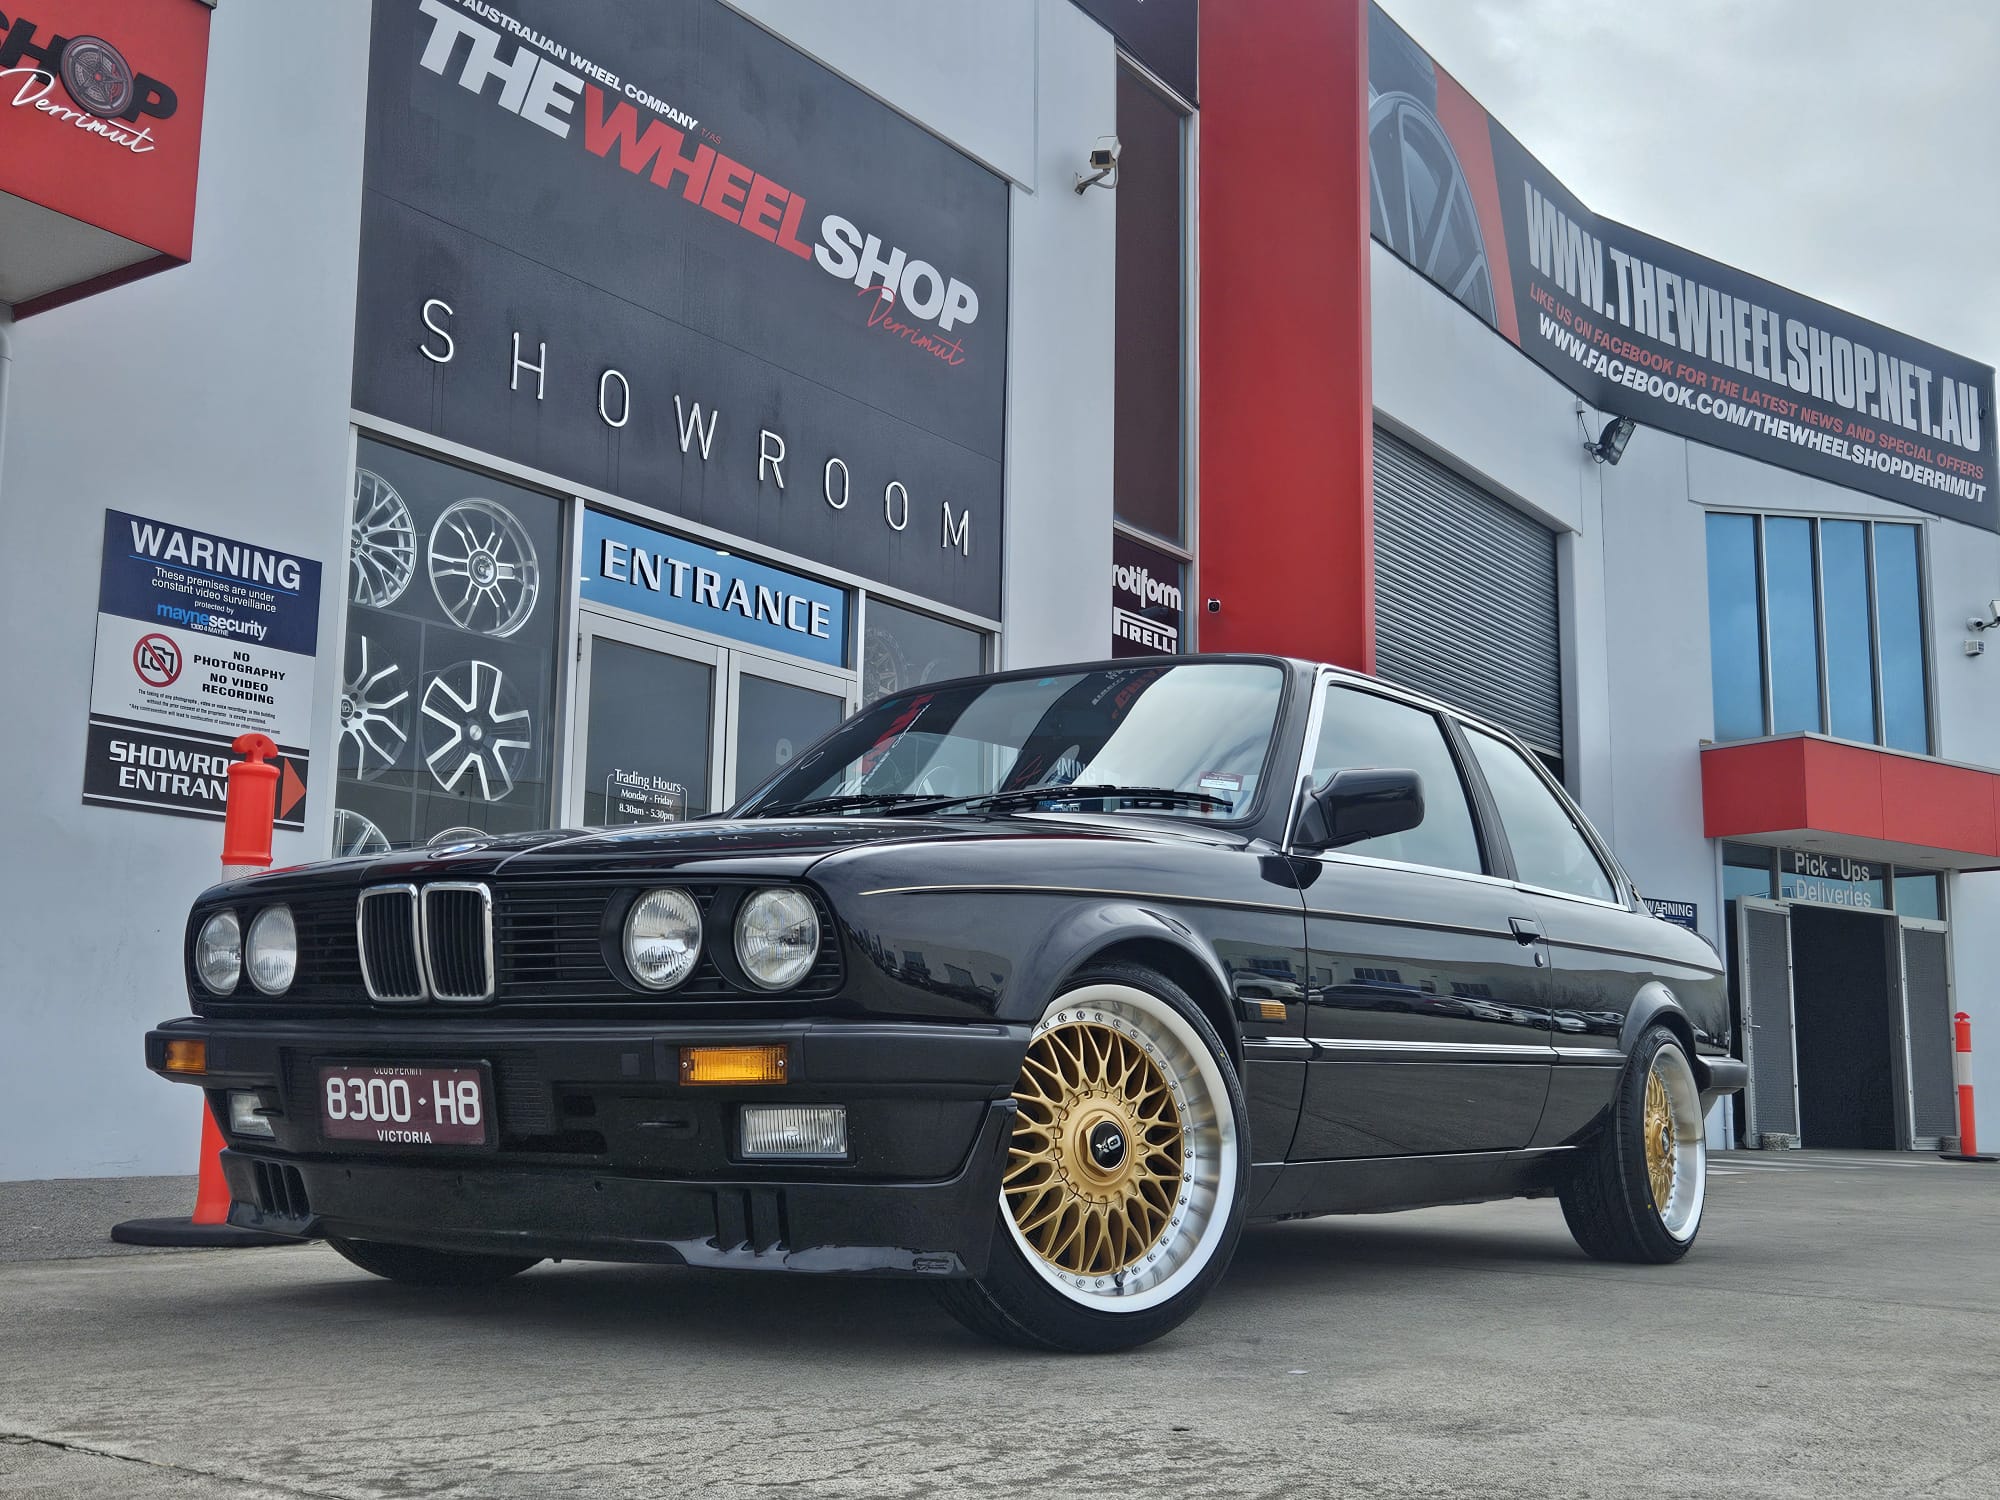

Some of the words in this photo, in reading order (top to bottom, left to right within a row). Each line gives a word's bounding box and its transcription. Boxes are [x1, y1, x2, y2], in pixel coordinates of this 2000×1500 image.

[462, 0, 568, 60] AUSTRALIAN
[570, 51, 621, 92] WHEEL
[625, 83, 699, 131] COMPANY
[0, 68, 155, 153] Derrimut
[419, 0, 585, 140] THE
[584, 81, 813, 261] WHEEL
[814, 214, 979, 332] SHOP
[857, 285, 965, 366] Derrimut
[1530, 282, 1554, 314] LIKE
[1556, 301, 1573, 326] US
[1573, 313, 1592, 338] ON
[1594, 327, 1672, 374] FACEBOOK
[1676, 363, 1707, 387] FOR
[1711, 376, 1739, 398] THE
[1742, 386, 1798, 417] LATEST
[1800, 406, 1844, 435] NEWS
[1846, 421, 1876, 446] AND
[1879, 433, 1934, 465] SPECIAL
[1936, 452, 1984, 480] OFFERS
[130, 520, 301, 591] WARNING
[152, 579, 193, 595] constant
[196, 586, 220, 600] video
[223, 594, 277, 613] surveillance
[155, 567, 184, 582] These
[187, 575, 229, 593] premises
[232, 585, 246, 596] are
[249, 587, 275, 602] under
[601, 537, 830, 639] ENTRANCE
[1113, 564, 1183, 611] rotiform
[194, 600, 225, 612] protected
[226, 606, 234, 615] by
[1113, 606, 1178, 655] PIRELLI
[193, 654, 286, 681] PHOTOGRAPHY
[233, 650, 250, 662] NO
[202, 683, 274, 705] RECORDING
[210, 672, 227, 684] NO
[232, 677, 269, 692] VIDEO
[109, 740, 241, 778] SHOWRO
[118, 766, 227, 802] ENTRAN
[614, 768, 650, 791] Trading
[653, 775, 682, 793] Hours
[619, 803, 644, 815] 8.30am
[650, 808, 674, 823] 5.30pm
[621, 789, 648, 803] Monday
[654, 794, 674, 808] Friday
[1794, 852, 1828, 877] Pick
[1840, 857, 1870, 886] Ups
[1644, 900, 1693, 917] WARNING
[1796, 879, 1872, 908] Deliveries
[376, 1129, 432, 1144] VICTORIA
